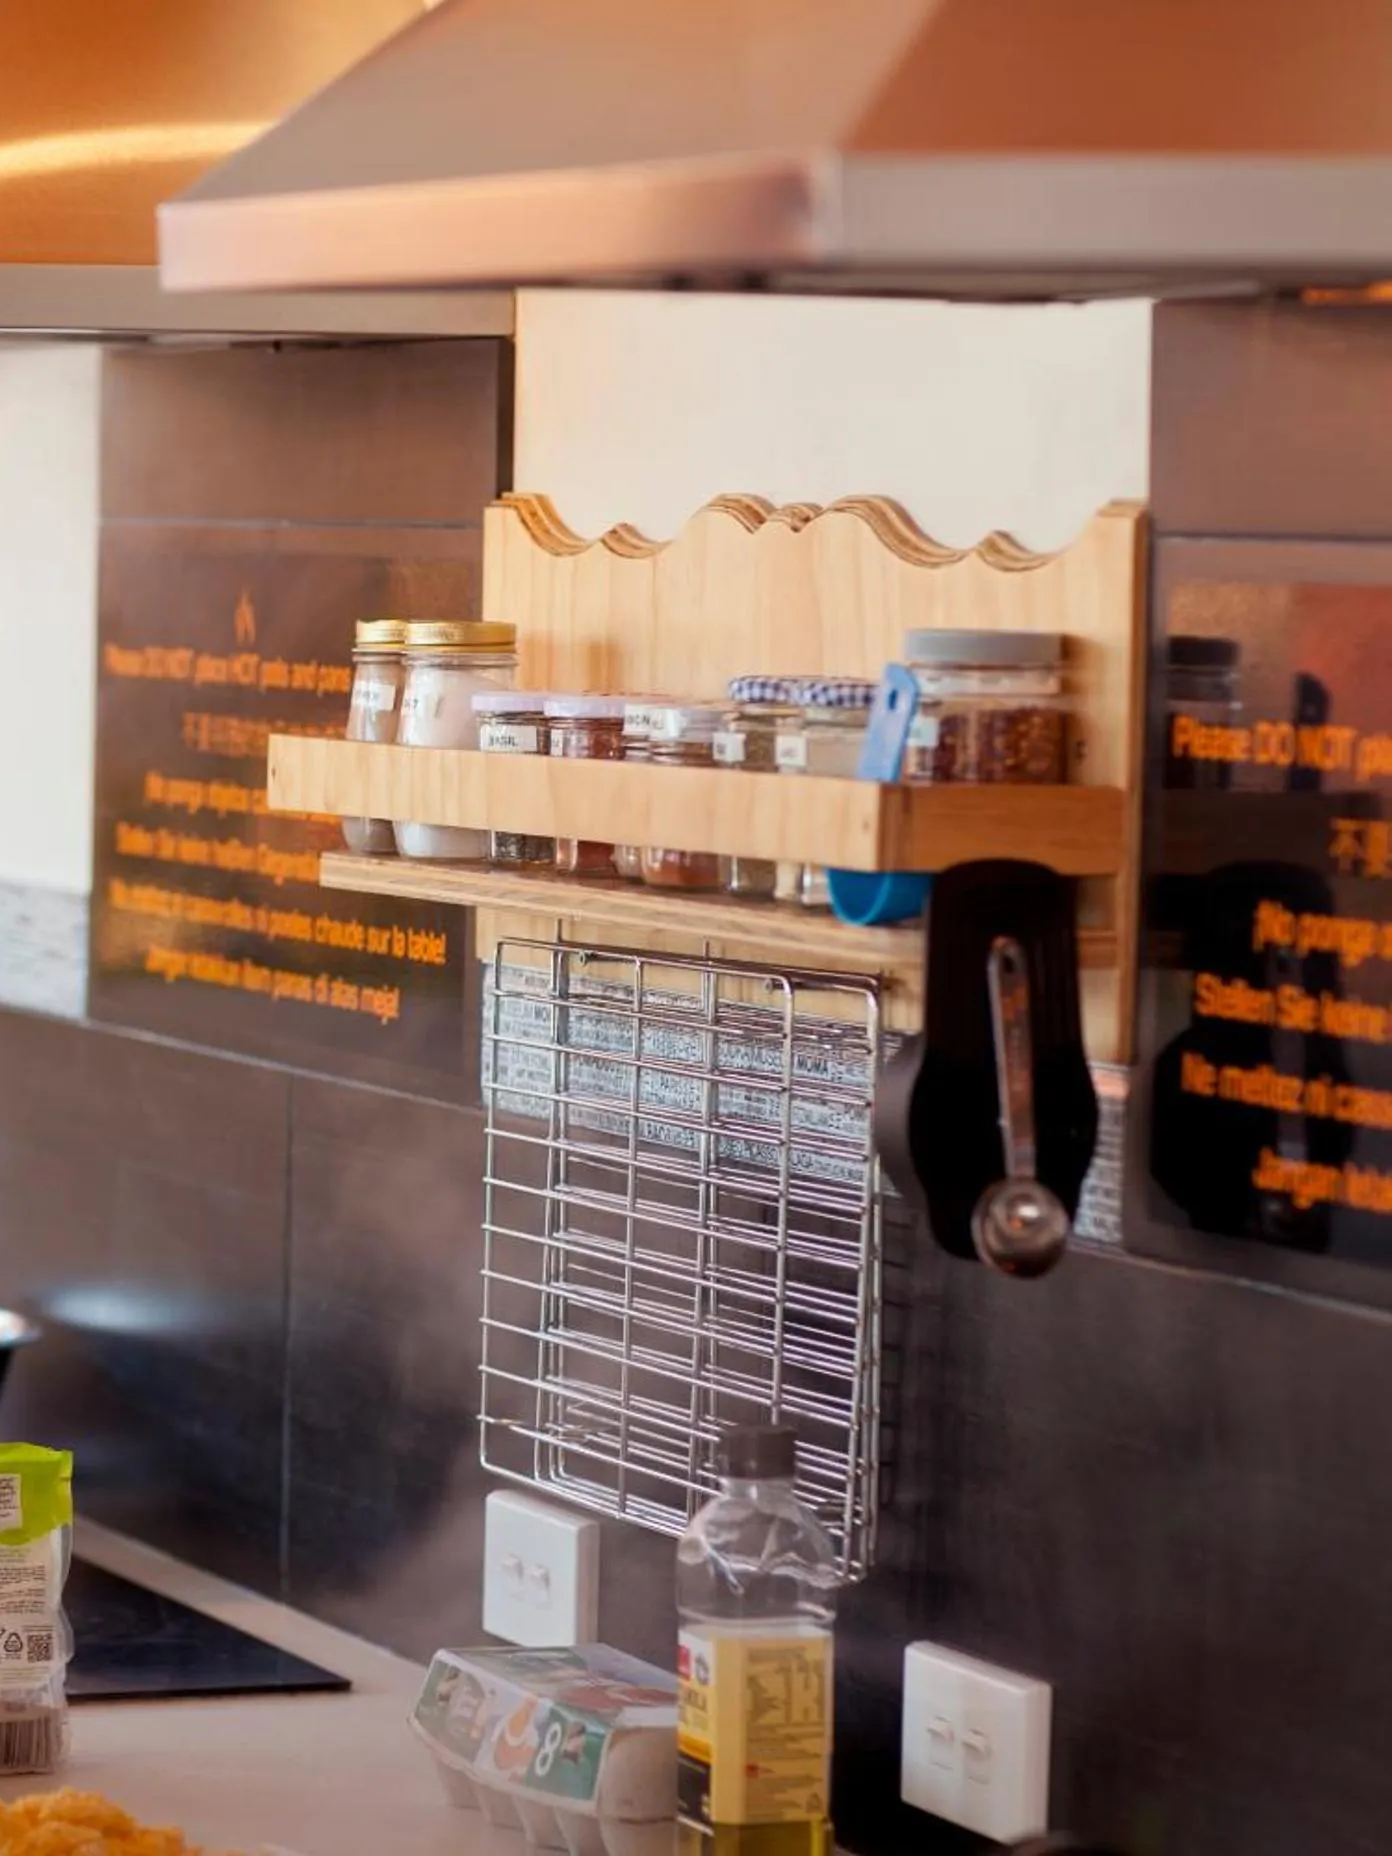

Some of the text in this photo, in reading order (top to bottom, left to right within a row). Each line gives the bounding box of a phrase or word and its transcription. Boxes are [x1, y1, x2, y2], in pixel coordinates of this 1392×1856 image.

[1173, 714, 1251, 762] Please
[1254, 719, 1296, 767] DO
[1298, 723, 1356, 772] NOT
[366, 926, 392, 955] sur
[392, 925, 406, 958] la
[408, 928, 447, 965] table!
[535, 1722, 561, 1777] 8
